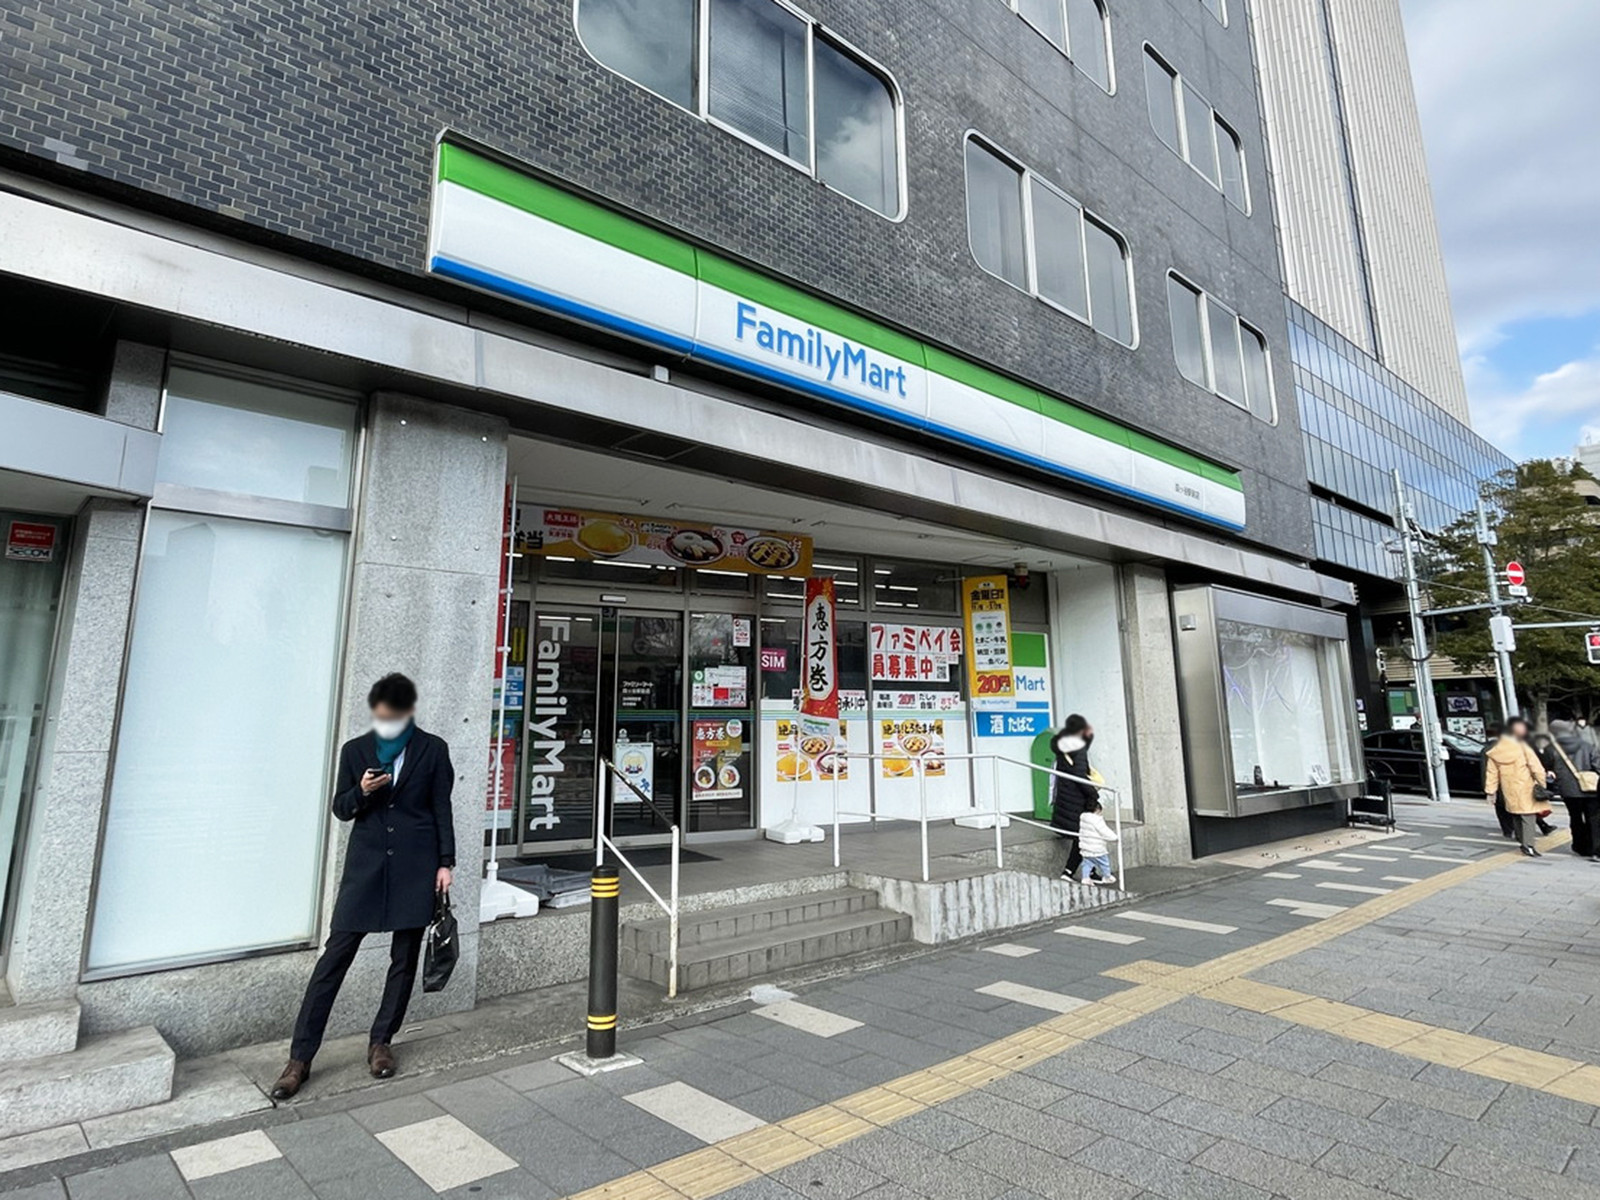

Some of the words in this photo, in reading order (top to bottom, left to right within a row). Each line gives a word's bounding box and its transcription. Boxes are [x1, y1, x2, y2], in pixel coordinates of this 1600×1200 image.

[737, 302, 906, 397] FamilyMart
[761, 655, 785, 668] SIM
[809, 603, 829, 692] 恵方巻
[873, 653, 933, 680] 員募集中
[529, 620, 570, 831] FamilyMart
[990, 715, 1004, 734] 酒
[1007, 716, 1035, 733] たばこ
